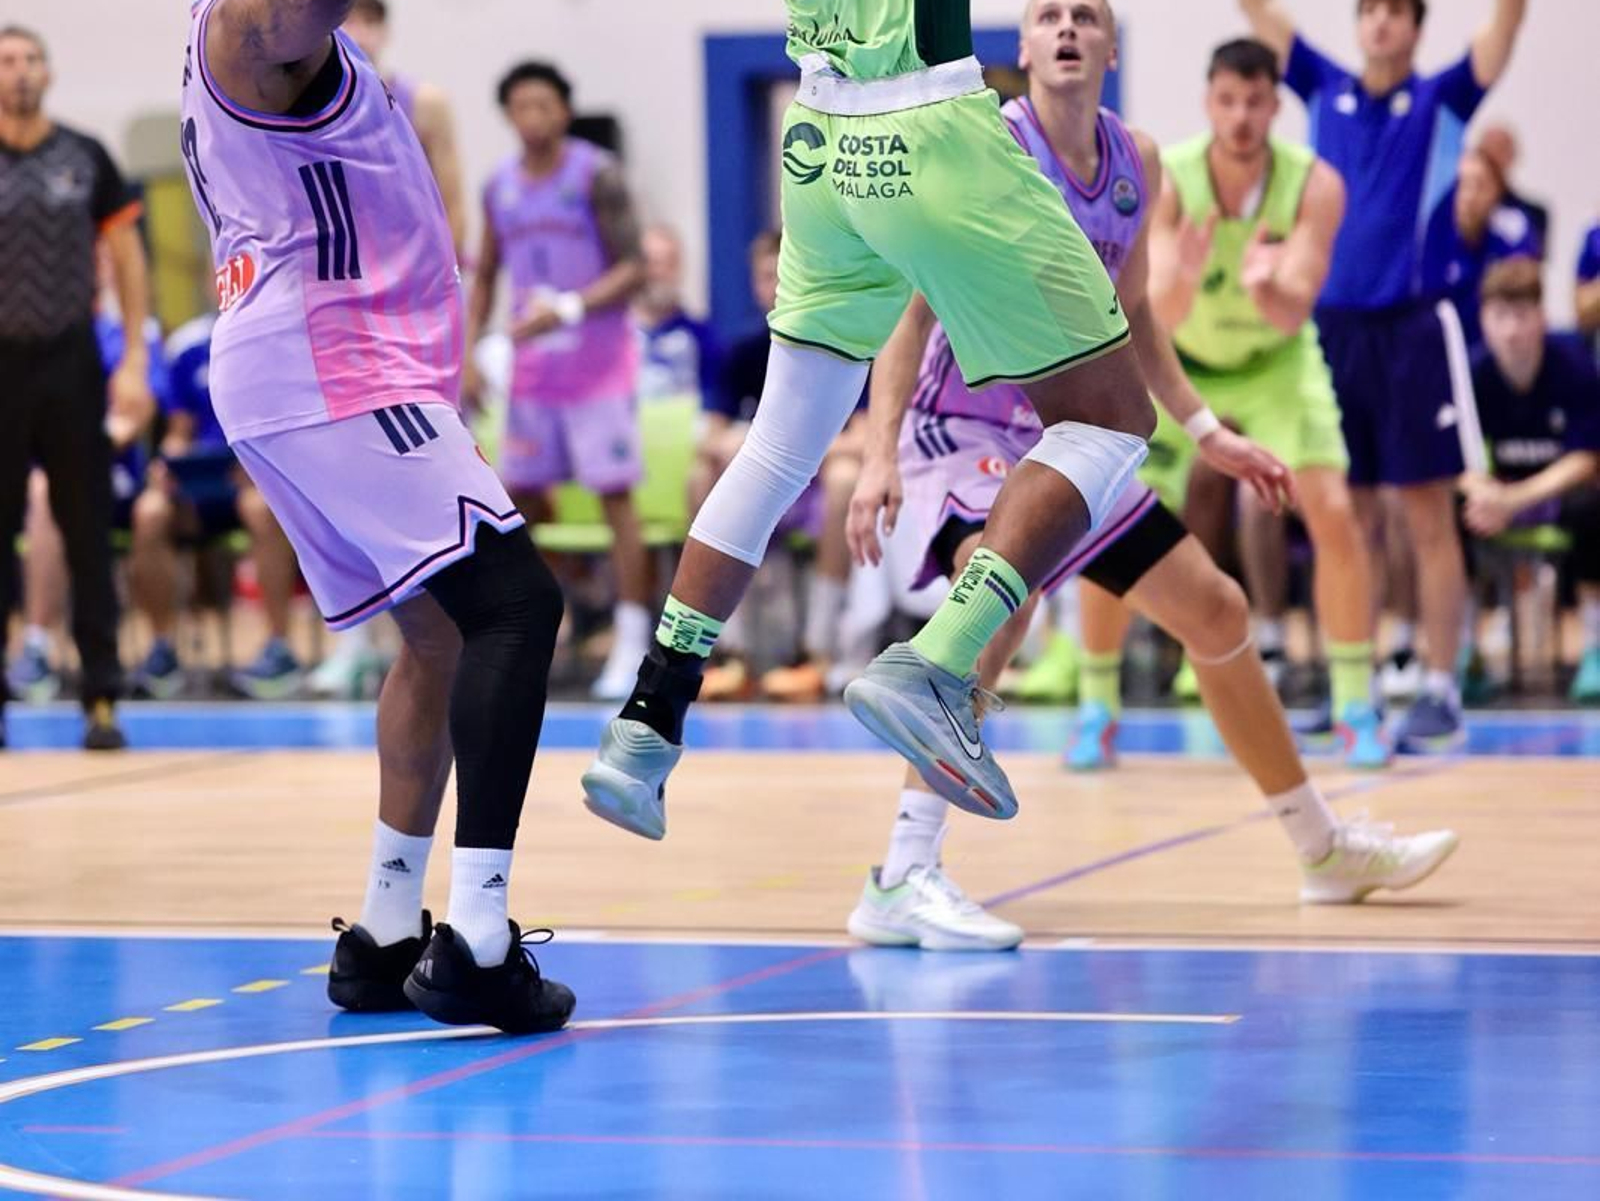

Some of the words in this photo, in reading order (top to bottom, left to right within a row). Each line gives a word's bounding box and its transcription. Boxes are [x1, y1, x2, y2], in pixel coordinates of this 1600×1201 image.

[838, 133, 909, 156] COSTA
[832, 158, 862, 177] DEL
[866, 160, 912, 178] SOL
